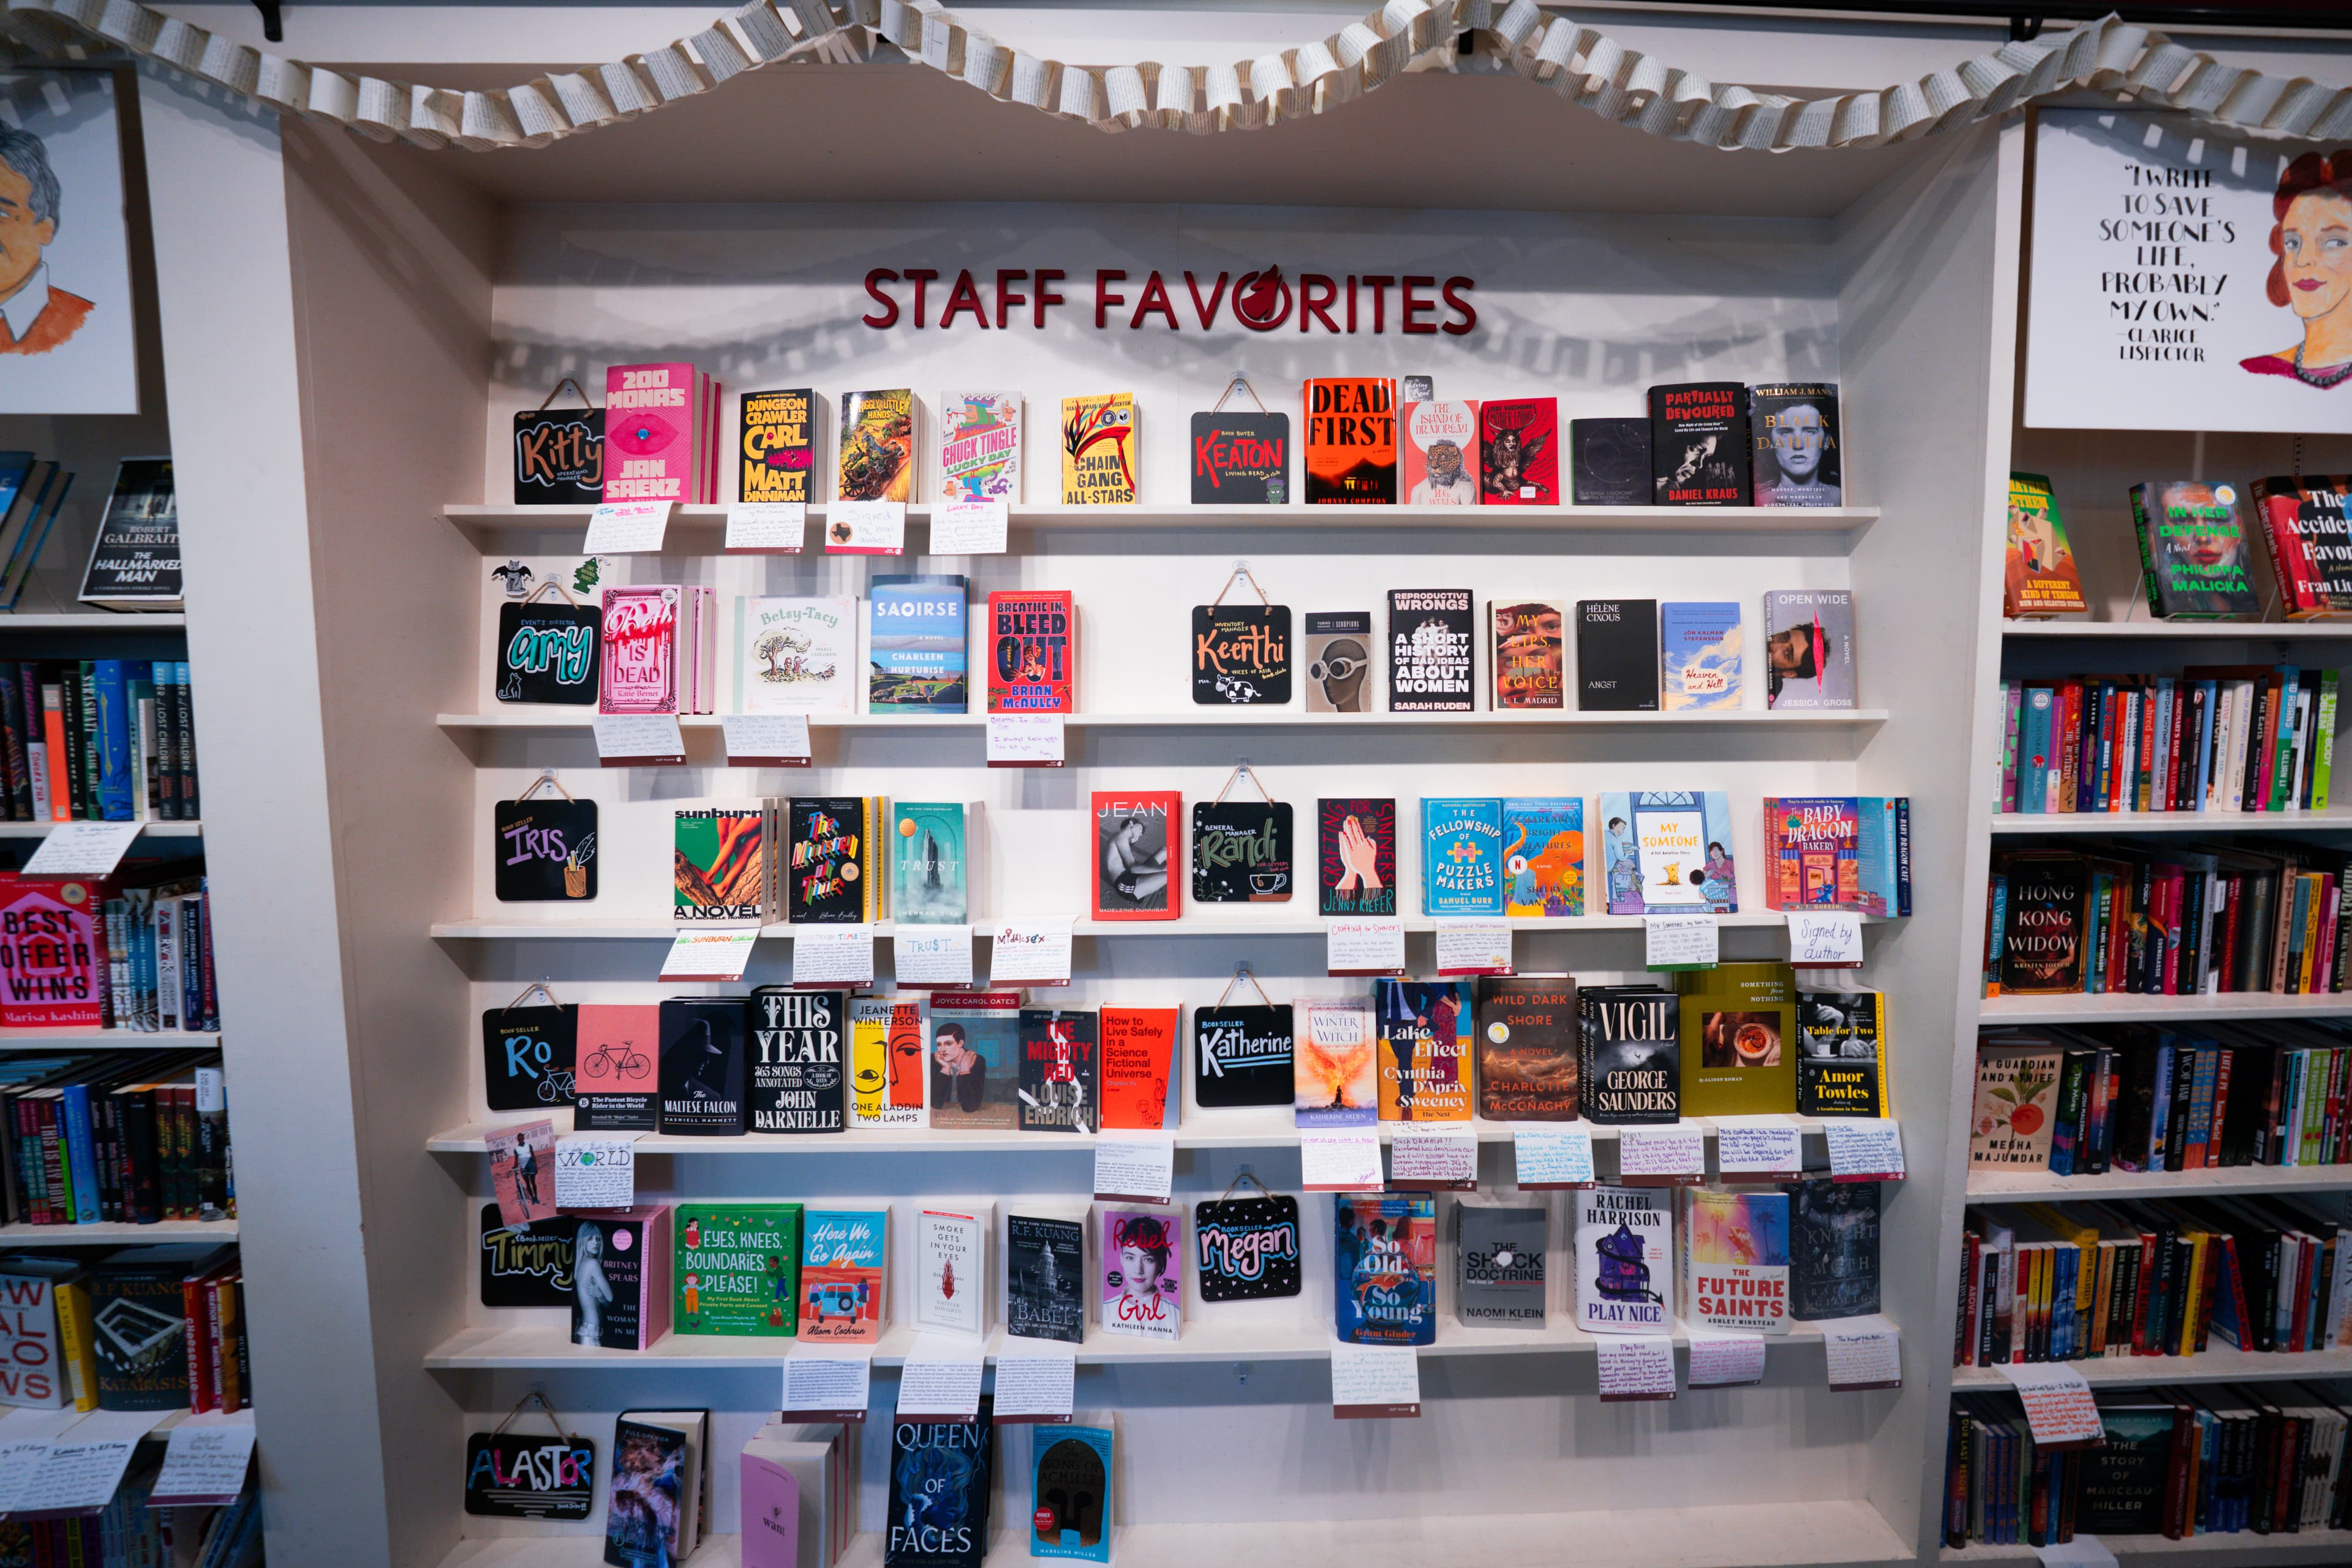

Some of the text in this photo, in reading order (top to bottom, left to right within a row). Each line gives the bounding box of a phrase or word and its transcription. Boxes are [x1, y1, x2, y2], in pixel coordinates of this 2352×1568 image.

[2146, 168, 2215, 188] WRITE
[2121, 194, 2214, 217] TO SAVE
[2098, 219, 2235, 243] SOMEONE'S
[2137, 246, 2194, 269] LIFE,
[2102, 272, 2228, 295] PROBABLY
[862, 264, 1478, 334] STAFF FAVORITES
[2110, 300, 2147, 321] MY
[2120, 345, 2205, 362] LISPECTOR
[623, 370, 669, 389] 200
[606, 388, 685, 410] MONAS
[747, 398, 807, 412] DUNGEON
[1313, 385, 1389, 413] DEAD
[1665, 390, 1733, 405] PARTIALLY
[745, 410, 807, 424] CRAWLER
[1666, 405, 1735, 420] DEVOURED
[1765, 415, 1829, 428] BLACK
[1308, 417, 1396, 446] FIRST
[744, 424, 808, 459] CARL
[943, 428, 1017, 464] CHUCK TINGLE
[1757, 437, 1836, 450] DAHLIA
[523, 426, 602, 483] Kitty
[946, 449, 1012, 475] LUCKY DAY
[1196, 430, 1283, 488] KEATON
[1074, 456, 1120, 473] CHAIN
[1077, 473, 1122, 488] GANG
[1066, 488, 1134, 505] ALL-STARS
[2168, 507, 2228, 518] IN HER
[2159, 525, 2241, 538] DEFENSE
[94, 560, 181, 570] HALLMARKED
[115, 571, 157, 582] MAN
[997, 602, 1066, 613] BREATHE IN,
[1395, 599, 1469, 611] WRONGS
[1587, 603, 1619, 613] HÉLÈNE
[1779, 595, 1848, 605] OPEN WIDE
[760, 606, 839, 629] Betsy-Tacy
[877, 602, 957, 617] SAOIRSE
[997, 614, 1066, 635] BLEED
[629, 647, 644, 662] IS
[1197, 625, 1284, 674] Keerthi
[997, 636, 1067, 682] OUT
[614, 667, 660, 684] DEAD
[891, 665, 944, 674] HURTUBISE
[1588, 680, 1617, 689] ANGST
[2143, 734, 2152, 766] sisters
[675, 809, 763, 818] sunburn
[1097, 802, 1167, 817] JEAN
[1803, 804, 1844, 824] BABY
[1429, 820, 1501, 841] FELLOWSHIP
[1660, 823, 1679, 834] MY
[1788, 821, 1852, 843] DRAGON
[504, 824, 567, 865] IRIS
[1201, 818, 1277, 869] Randi
[1643, 836, 1698, 847] SOMEONE
[1803, 840, 1834, 851] BAKERY
[901, 861, 959, 871] TRUST
[1436, 862, 1493, 878] PUZZLE
[1436, 875, 1494, 891] MAKERS
[2019, 885, 2075, 900] HONG
[674, 905, 761, 918] A NOVEL
[2019, 910, 2071, 925] KONG
[6, 911, 73, 934] BEST
[1801, 919, 1853, 946] Signed by
[2008, 936, 2078, 951] WIDOW
[1, 943, 91, 969] OFFER
[1804, 946, 1845, 960] author
[10, 976, 88, 1001] WINS
[762, 995, 831, 1029] THIS
[1046, 1020, 1075, 1039] THE
[1106, 1016, 1144, 1026] How to
[1599, 1002, 1675, 1041] VIGIL
[1106, 1027, 1163, 1038] Live Safely
[1383, 1025, 1430, 1041] Lake
[755, 1030, 840, 1063] YEAR
[1028, 1041, 1091, 1061] MIGHTY
[1199, 1028, 1292, 1077] Katherine
[1415, 1042, 1467, 1057] Effect
[1044, 1063, 1075, 1082] RED
[1983, 1059, 2056, 1069] A GUARDIAN
[1820, 1069, 1864, 1083] Amor
[1981, 1073, 2054, 1083] AND A THIEF
[1815, 1085, 1869, 1099] Towles
[665, 1101, 737, 1113] MALTESE FALCON
[704, 1231, 783, 1250] EYES, KNEES,
[603, 1260, 638, 1270] BRITNEY
[608, 1273, 638, 1282] SPEARS
[1698, 1277, 1784, 1297] FUTURE
[1017, 1304, 1074, 1325] BABEL
[1467, 1308, 1544, 1318] NAOMI KLEIN
[1589, 1303, 1662, 1322] PLAY NICE
[1698, 1298, 1784, 1317] SAINTS
[896, 1423, 979, 1452] QUEEN
[468, 1446, 590, 1491] ALASTOR
[925, 1479, 945, 1493] OF
[891, 1527, 971, 1553] FACES
